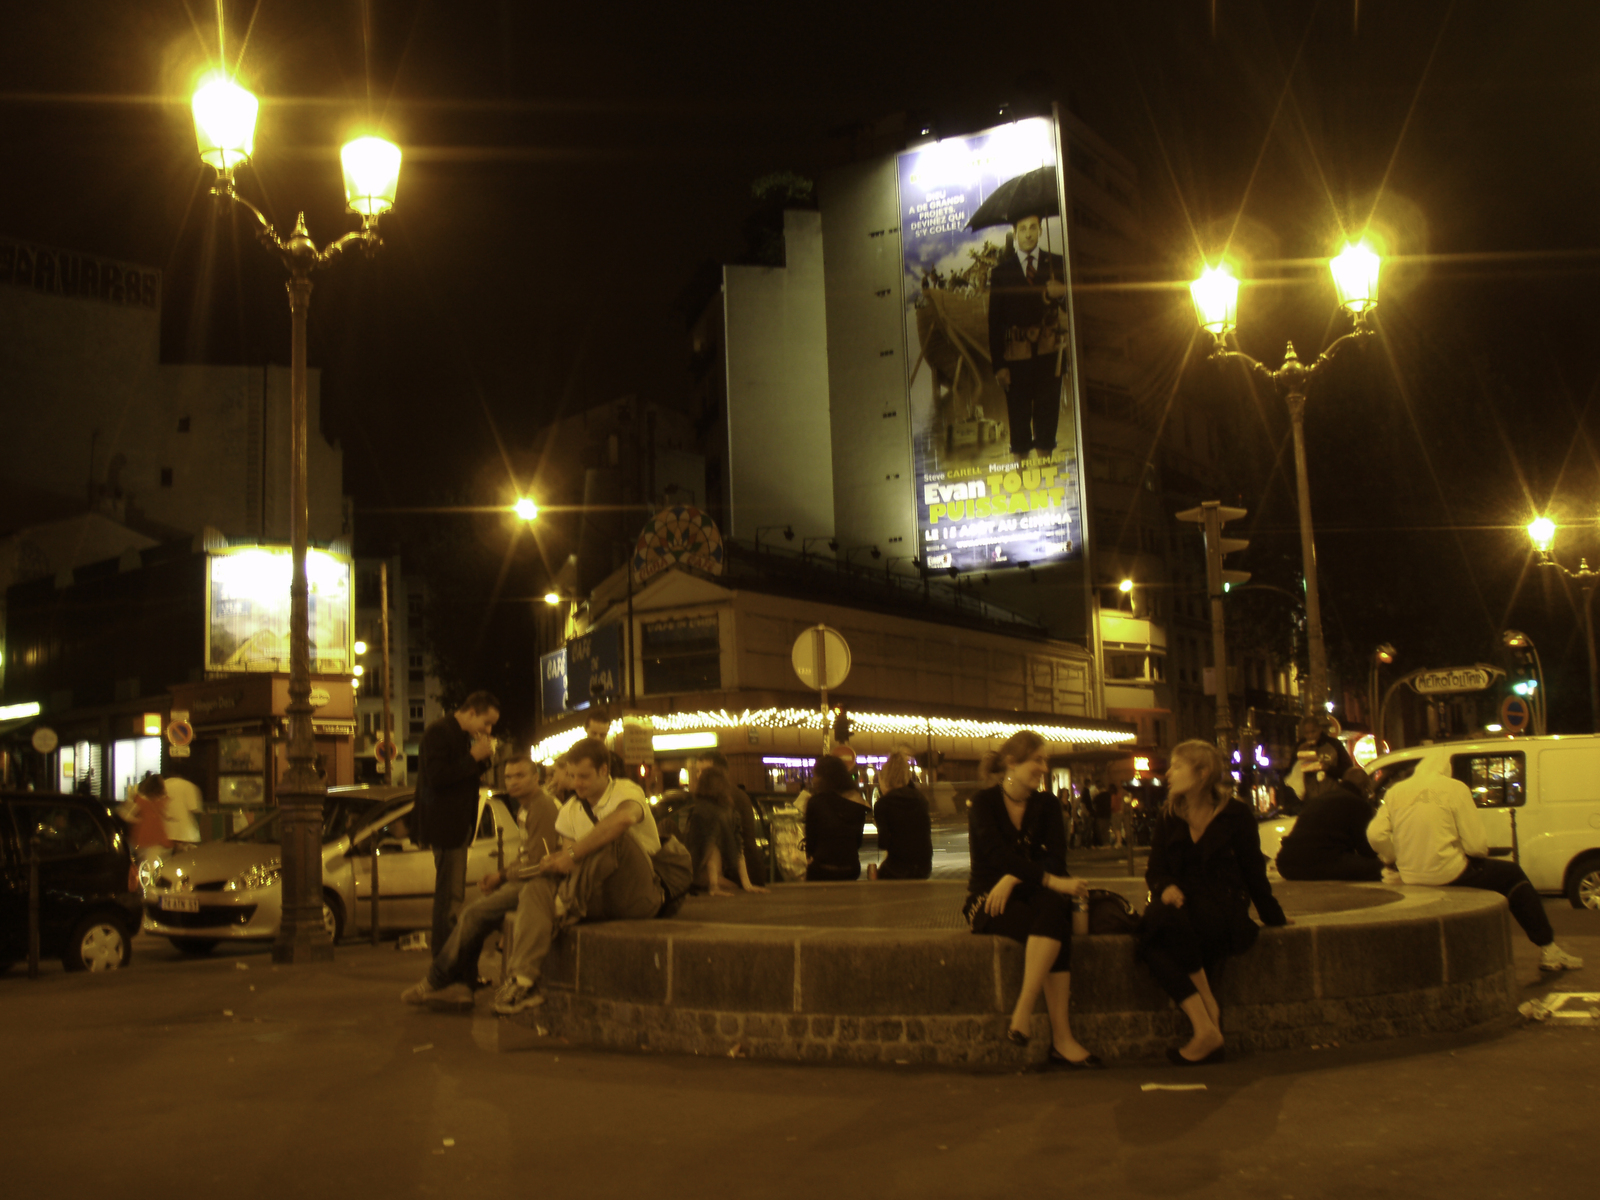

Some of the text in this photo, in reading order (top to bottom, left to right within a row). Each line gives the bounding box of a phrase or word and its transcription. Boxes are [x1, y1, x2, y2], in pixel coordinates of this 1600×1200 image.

[909, 194, 965, 215] A DE GRANDS
[926, 190, 947, 202] DIEU
[911, 211, 965, 231] DEVINEZ QUI
[915, 228, 928, 238] S'Y
[923, 454, 1066, 483] Steve CARELL Morgan FREEMAN
[924, 466, 1070, 505] Evan TOUT-
[929, 487, 1066, 524] PUISSANT
[925, 528, 940, 542] LE
[943, 525, 957, 539] 15
[998, 518, 1018, 533] AU
